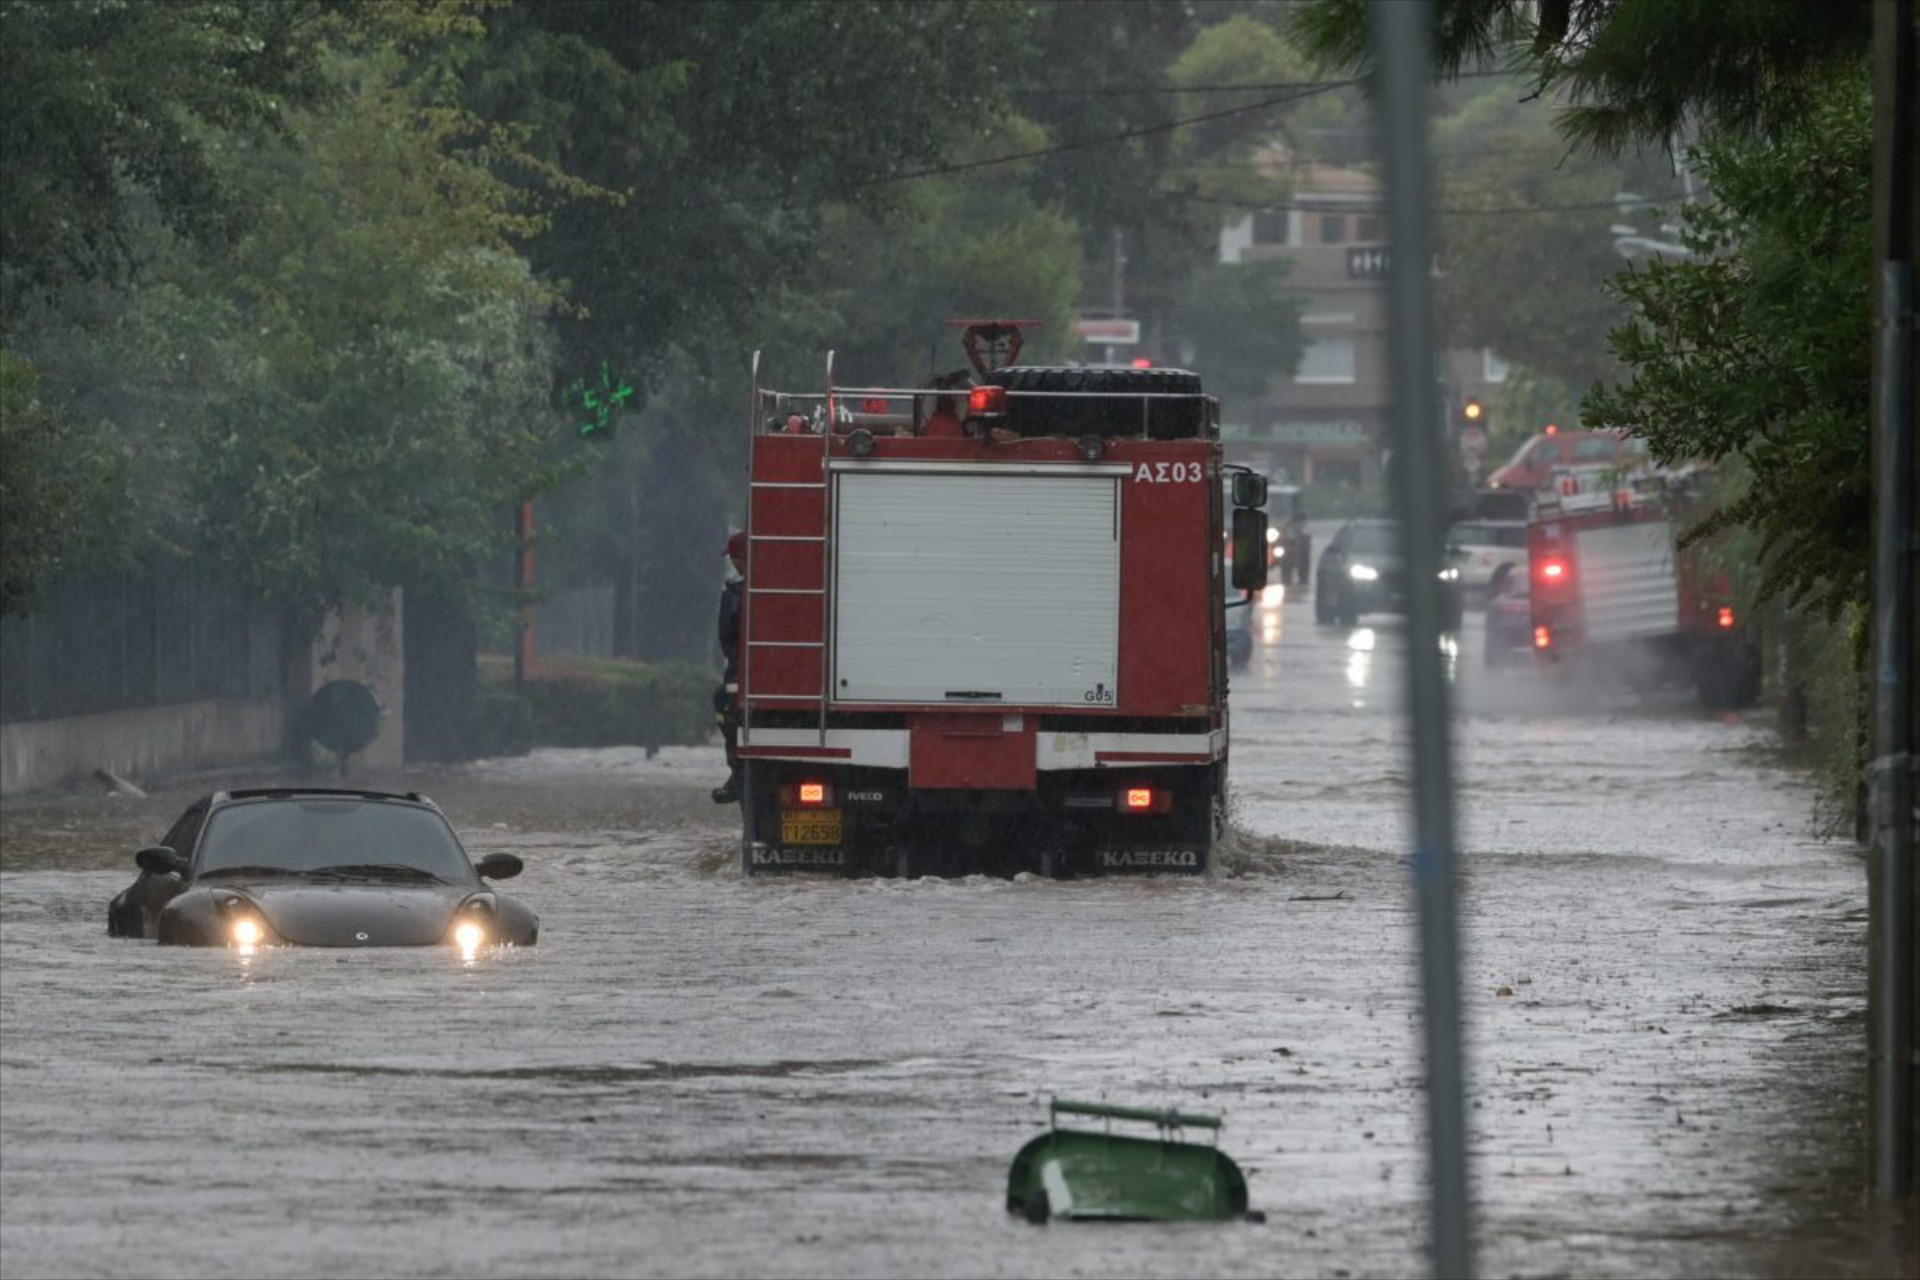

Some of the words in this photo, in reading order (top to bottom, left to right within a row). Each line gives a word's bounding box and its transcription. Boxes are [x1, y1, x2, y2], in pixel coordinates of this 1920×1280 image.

[1134, 461, 1202, 483] ΑΣ03
[1084, 690, 1112, 702] G05
[847, 791, 883, 801] IVECO
[1103, 850, 1198, 867] ΚΑΞΕΚΩ
